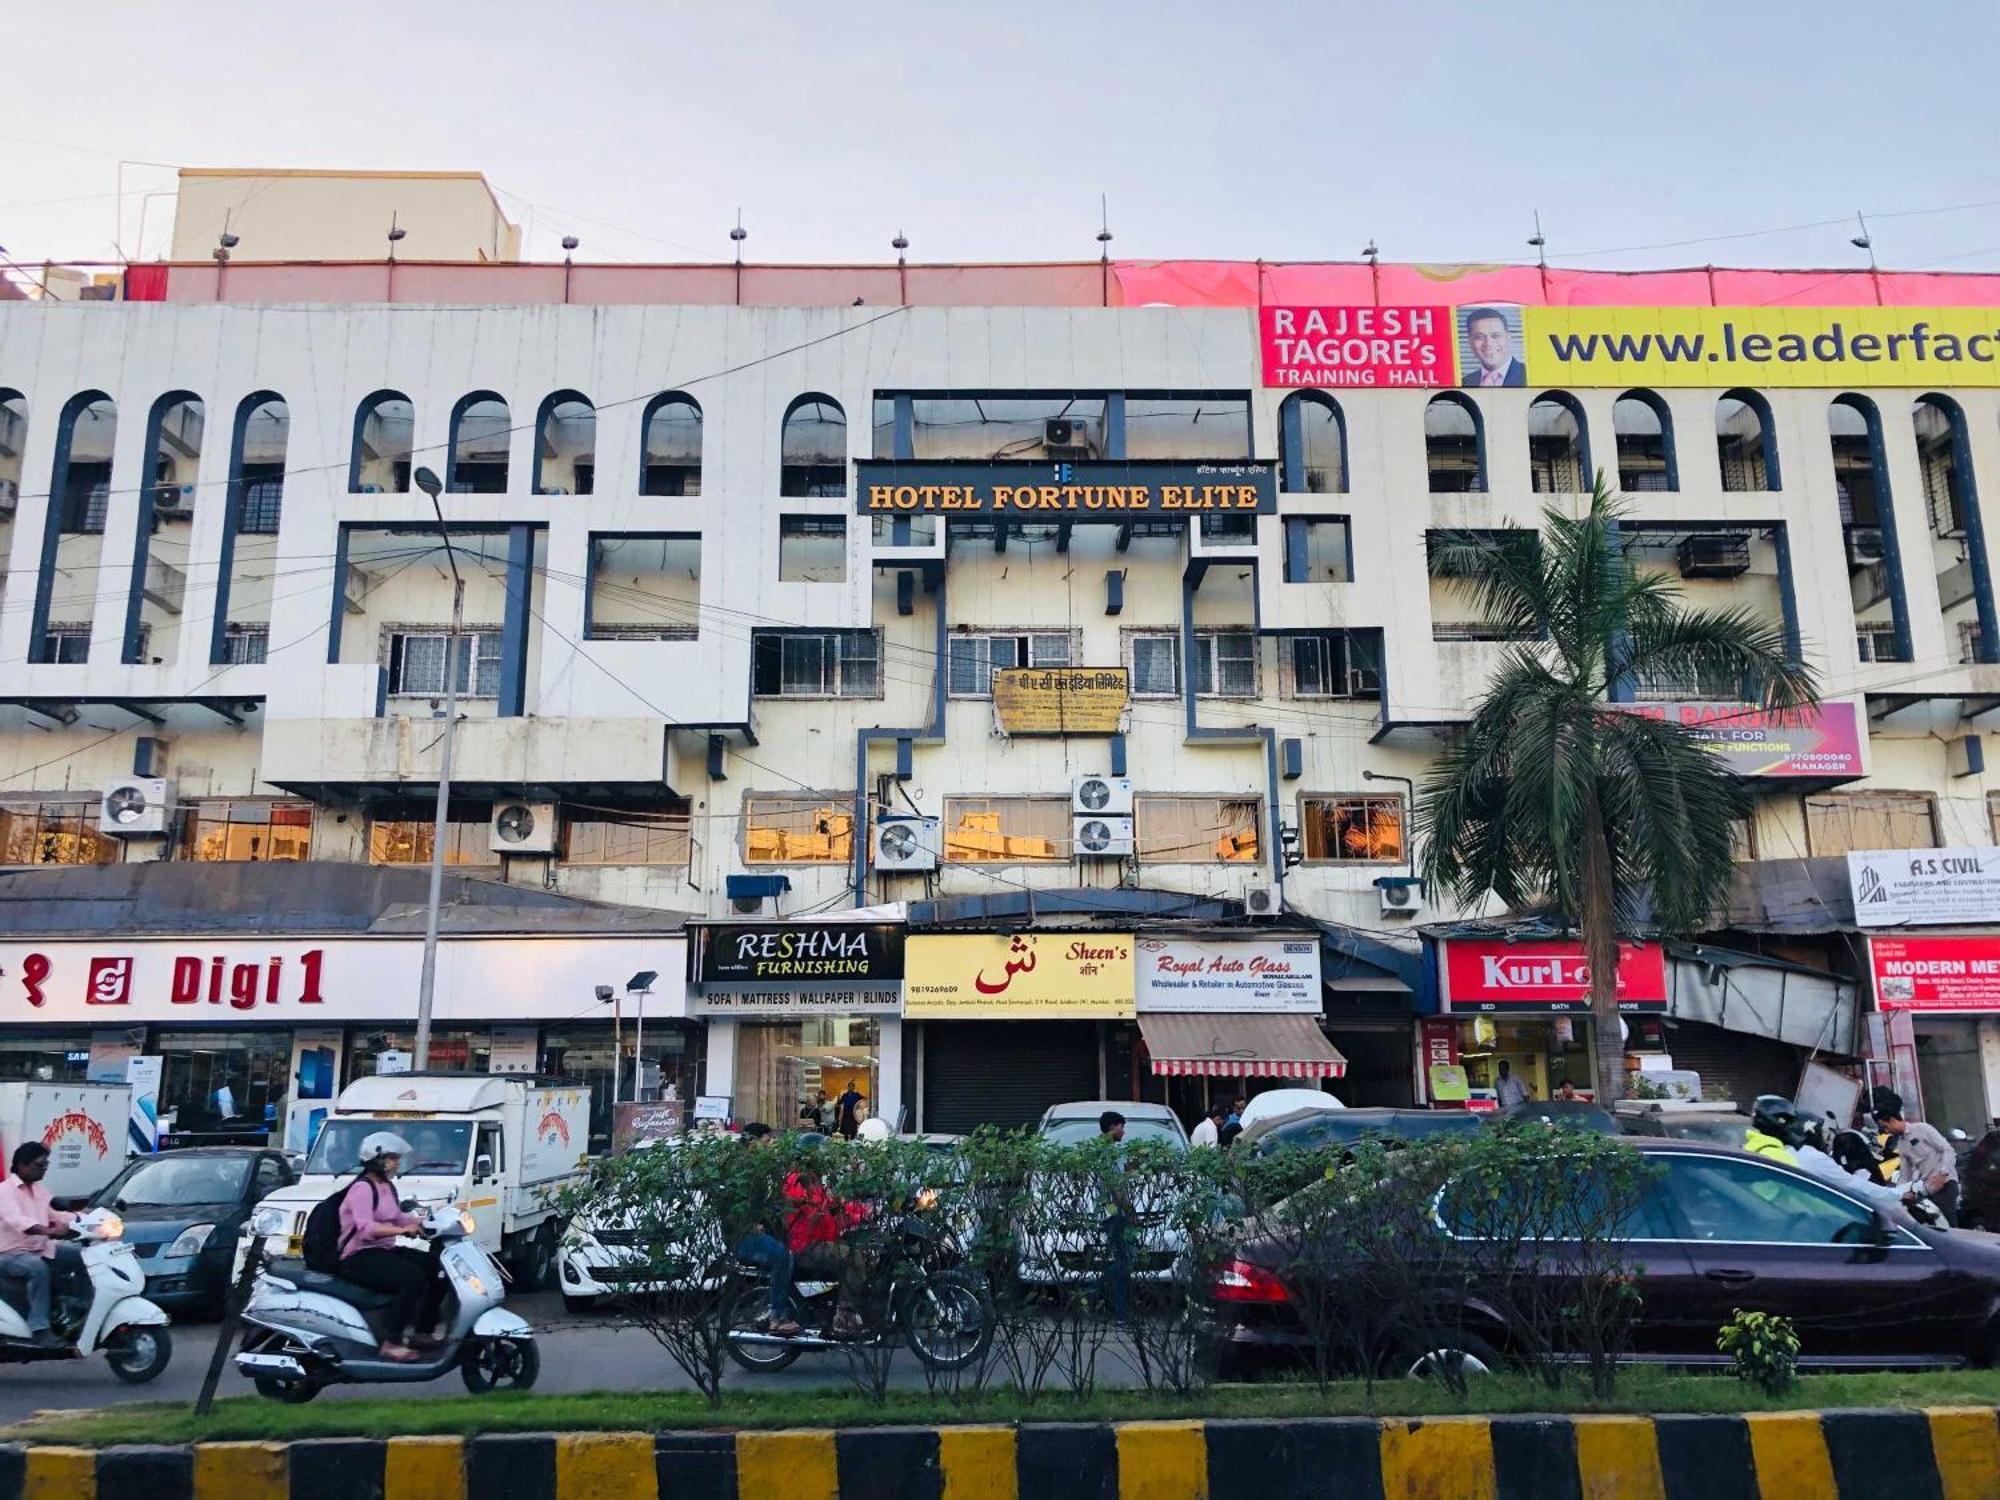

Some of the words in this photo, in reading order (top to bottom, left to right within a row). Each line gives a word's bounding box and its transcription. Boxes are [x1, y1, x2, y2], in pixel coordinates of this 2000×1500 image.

[1274, 309, 1433, 336] RAJESH
[1273, 337, 1437, 365] TAGORE's
[1275, 369, 1375, 385] TRAINING
[1389, 369, 1439, 385] HALL
[868, 485, 982, 509] HOTEL
[992, 485, 1151, 509] FORTUNE
[1160, 485, 1259, 508] ELITE
[1732, 731, 1764, 740] FOR
[1727, 743, 1792, 753] FUNCTIONS
[1910, 859, 1938, 876] A.S
[1942, 858, 1985, 874] CIVIL
[736, 930, 869, 959] RESHMA
[1065, 942, 1128, 961] Sheen's
[756, 960, 869, 976] FURNISHING
[1157, 955, 1205, 976] Royal
[1207, 955, 1245, 974] Auto
[1249, 956, 1292, 977] Glass
[1480, 955, 1626, 988] Kurl-o
[1886, 960, 1966, 975] MODERN
[1970, 960, 2000, 975] ME
[171, 956, 284, 1009] Digi
[298, 949, 325, 1004] 1
[1151, 979, 1190, 989] Wholesaler
[1198, 979, 1226, 989] Retailer
[1235, 979, 1275, 990] Automotive
[707, 993, 732, 1005] SOFA
[741, 992, 790, 1005] MATTRESS
[799, 992, 855, 1005] WALLPAPER
[863, 991, 897, 1004] BLINDS
[1481, 1003, 1496, 1011] BED
[1551, 1003, 1570, 1011] BATH
[1618, 1002, 1639, 1010] MORE
